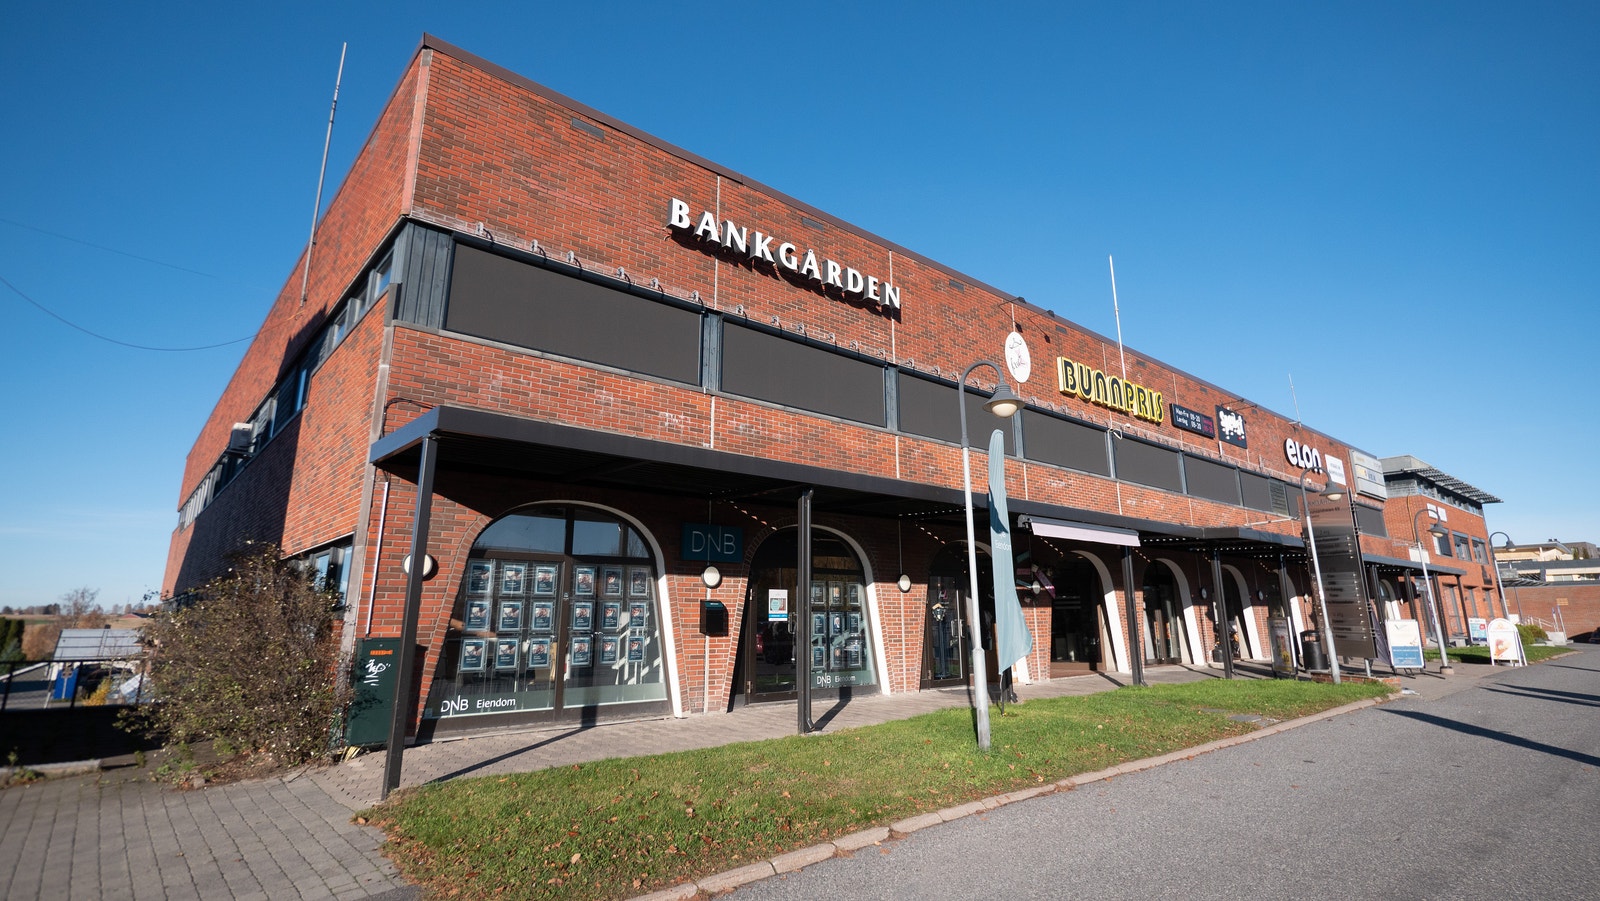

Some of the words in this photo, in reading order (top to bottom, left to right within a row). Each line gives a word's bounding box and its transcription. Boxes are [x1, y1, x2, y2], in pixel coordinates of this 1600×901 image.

[667, 197, 901, 309] BANKGÅRDEN
[692, 526, 736, 565] DNB
[816, 672, 831, 687] DNB
[440, 694, 469, 716] DNB
[476, 697, 516, 709] Eiendom
